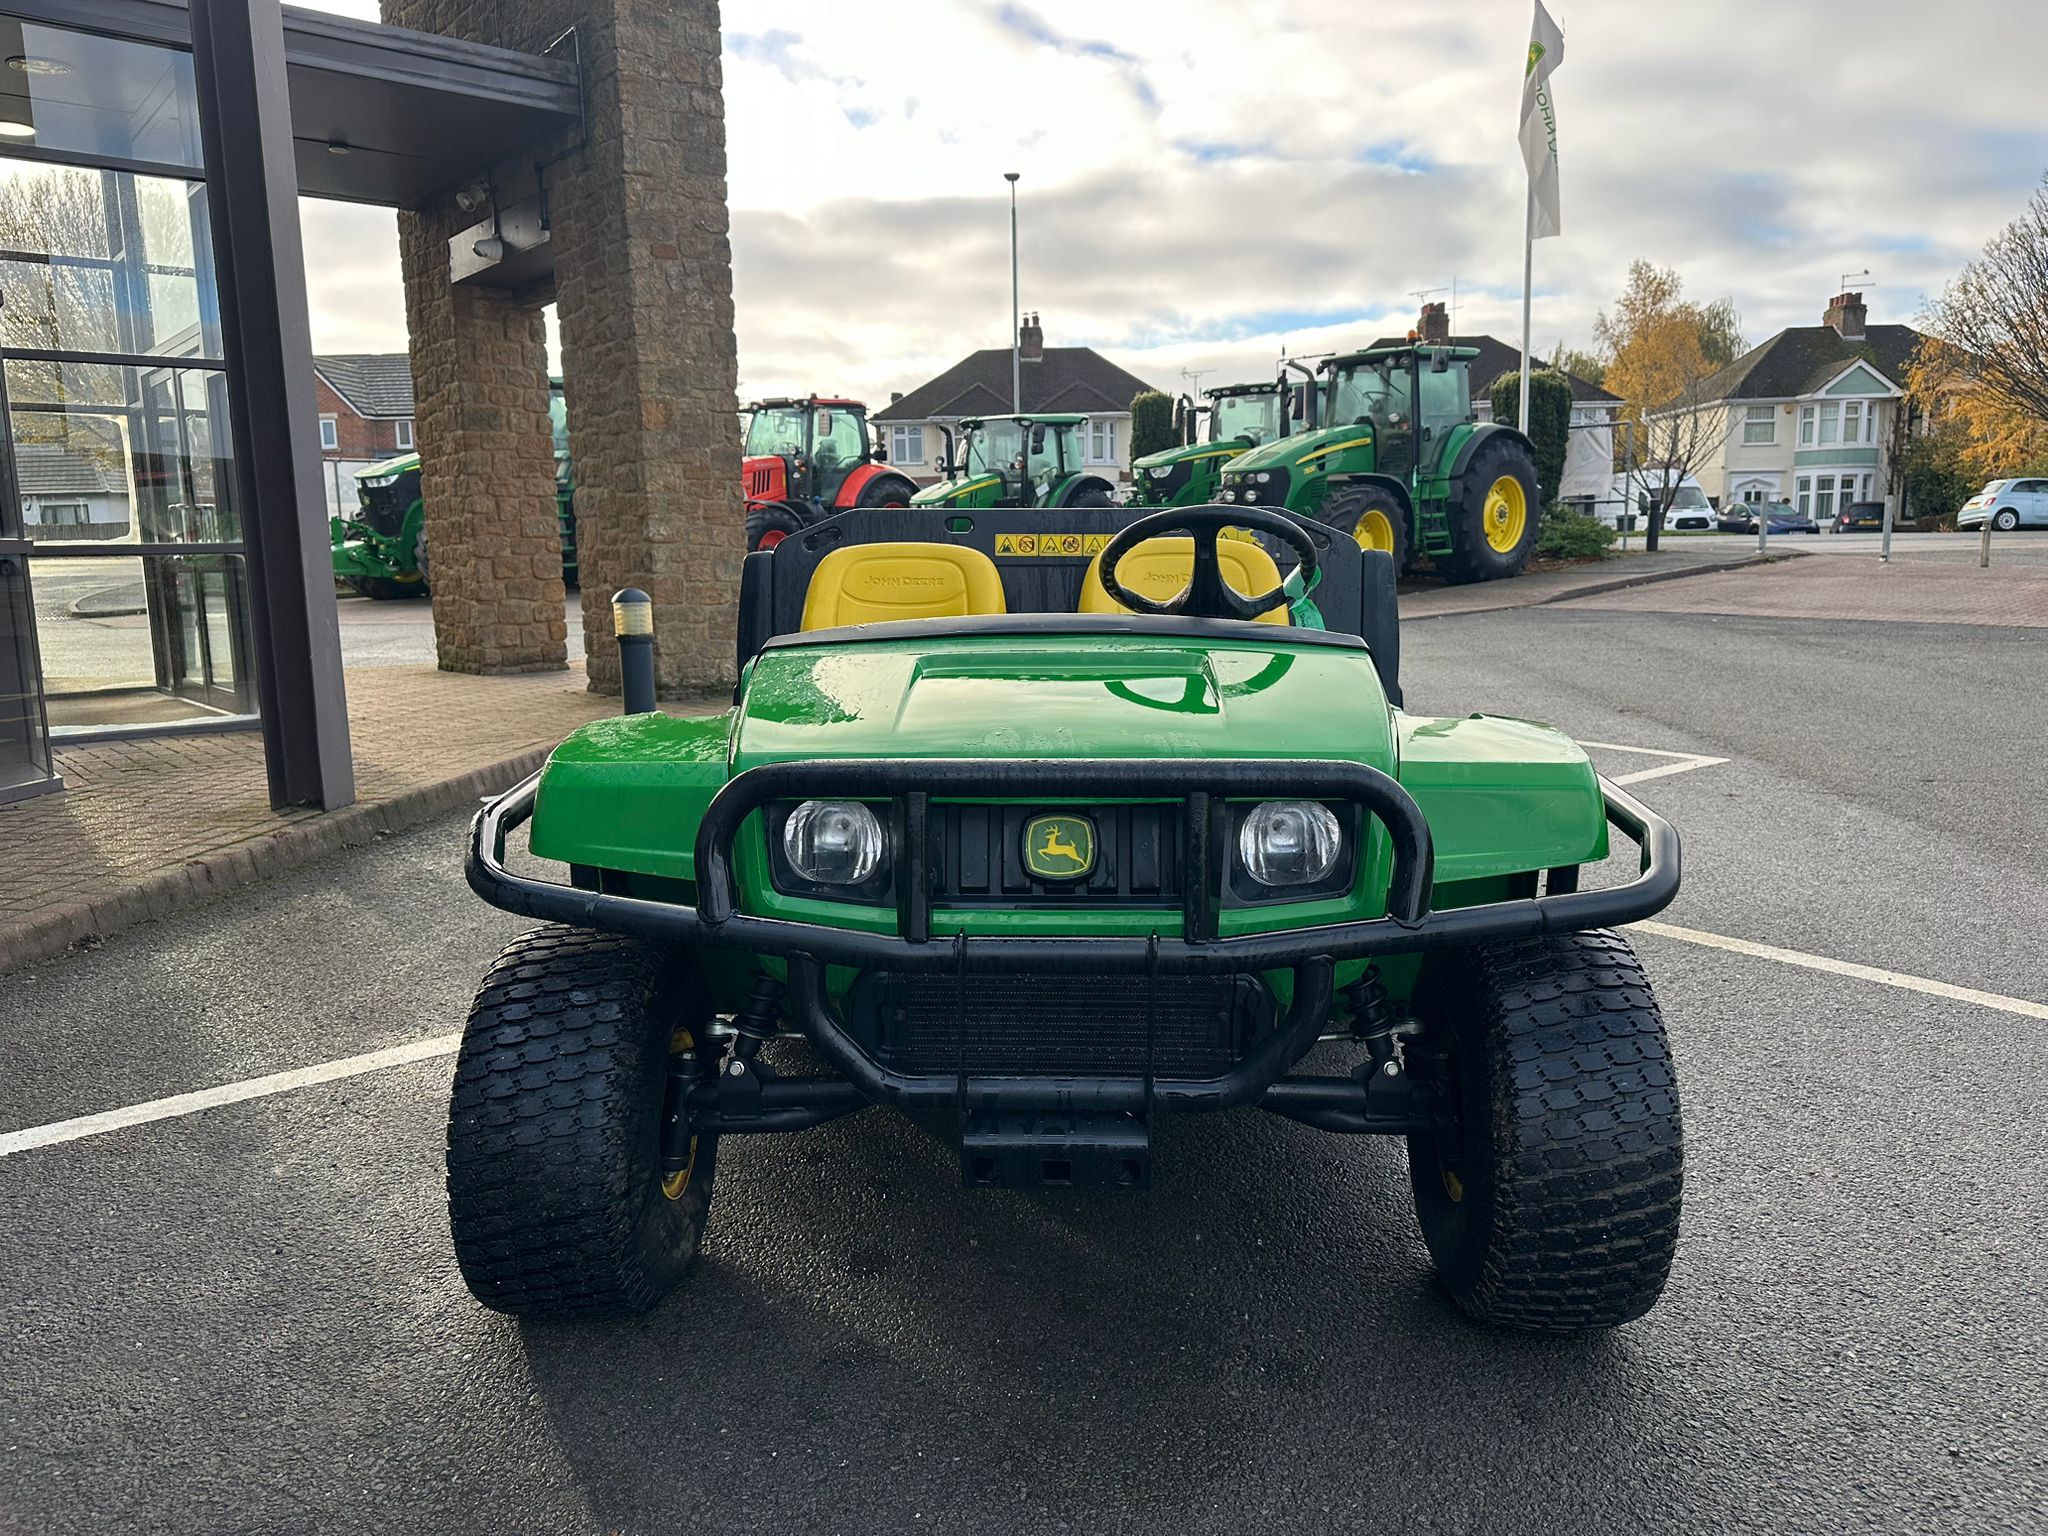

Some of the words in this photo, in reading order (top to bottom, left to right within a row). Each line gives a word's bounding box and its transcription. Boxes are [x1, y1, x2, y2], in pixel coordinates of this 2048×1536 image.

[864, 575, 900, 587] JOHN
[901, 575, 945, 587] DEERE
[1143, 571, 1180, 584] JOHN
